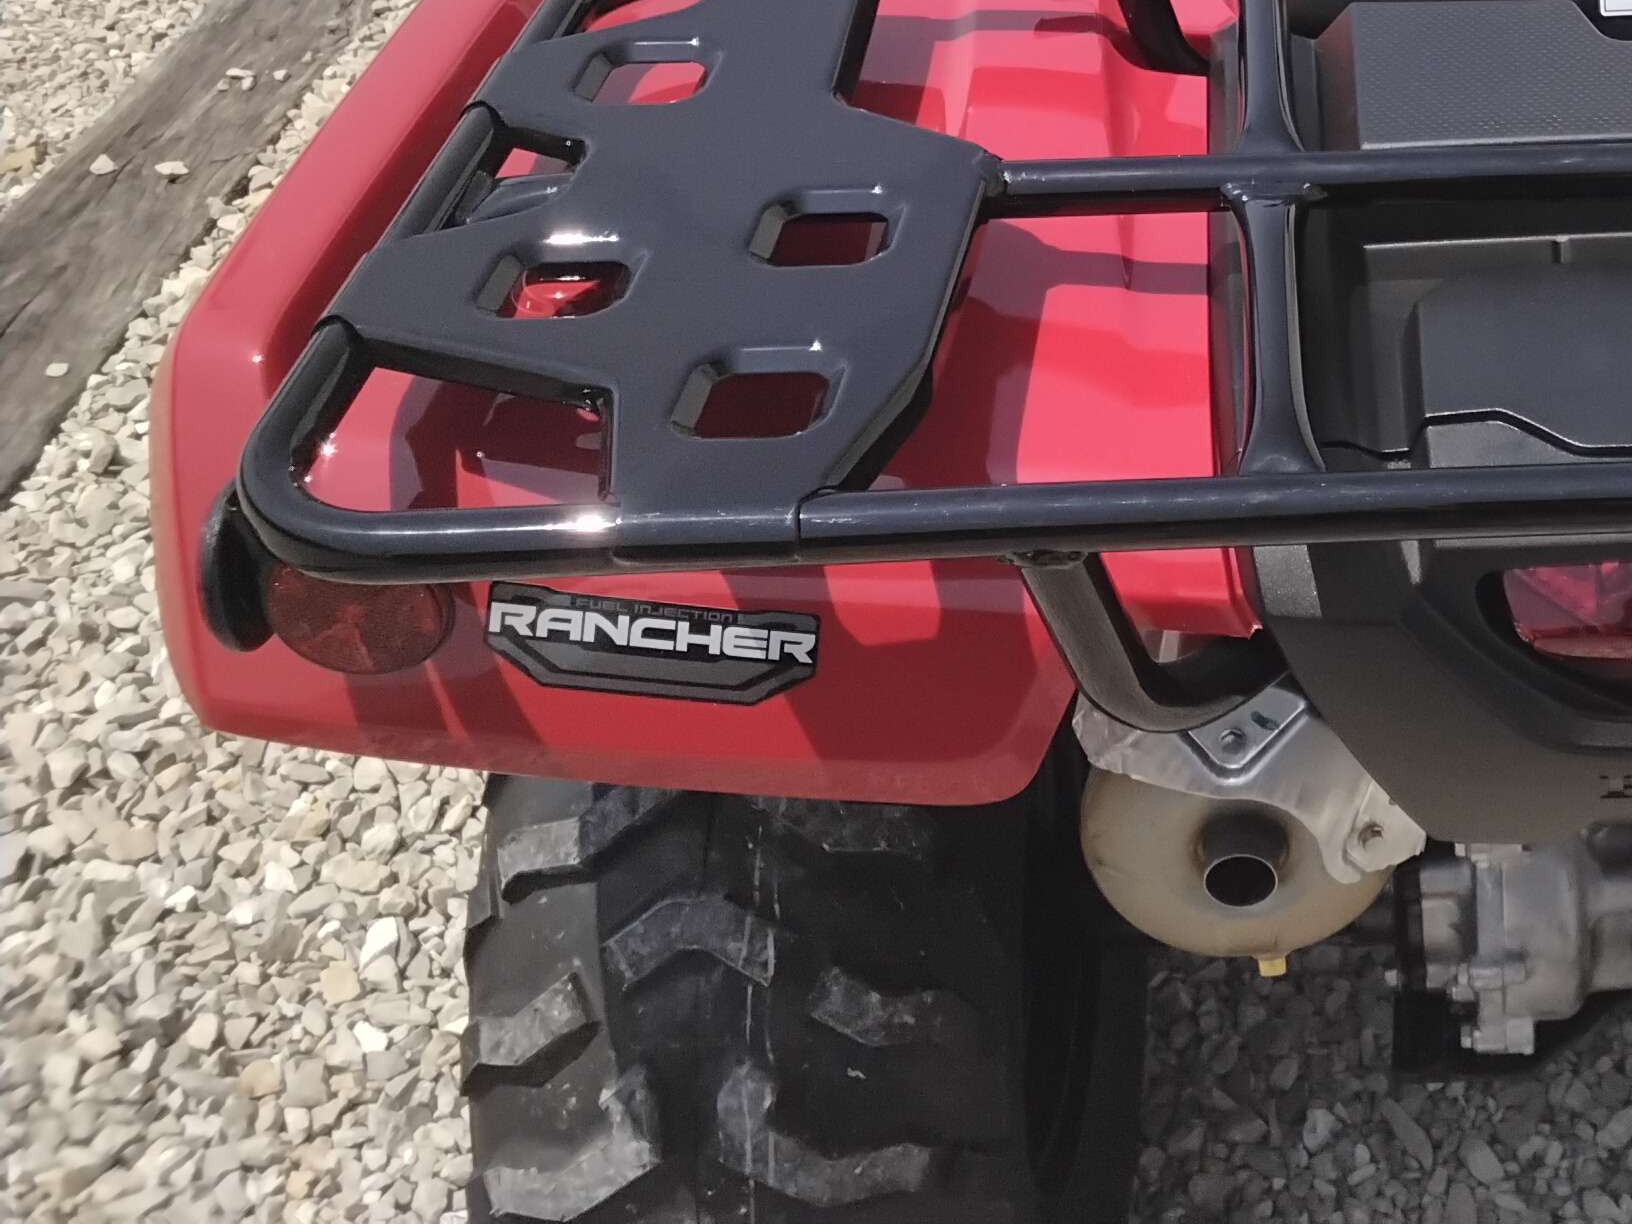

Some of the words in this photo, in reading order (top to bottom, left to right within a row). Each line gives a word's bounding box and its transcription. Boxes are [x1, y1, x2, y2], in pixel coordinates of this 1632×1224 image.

[488, 601, 816, 664] RANCHER
[575, 598, 629, 613] FUEL
[634, 603, 733, 624] INJECTION
